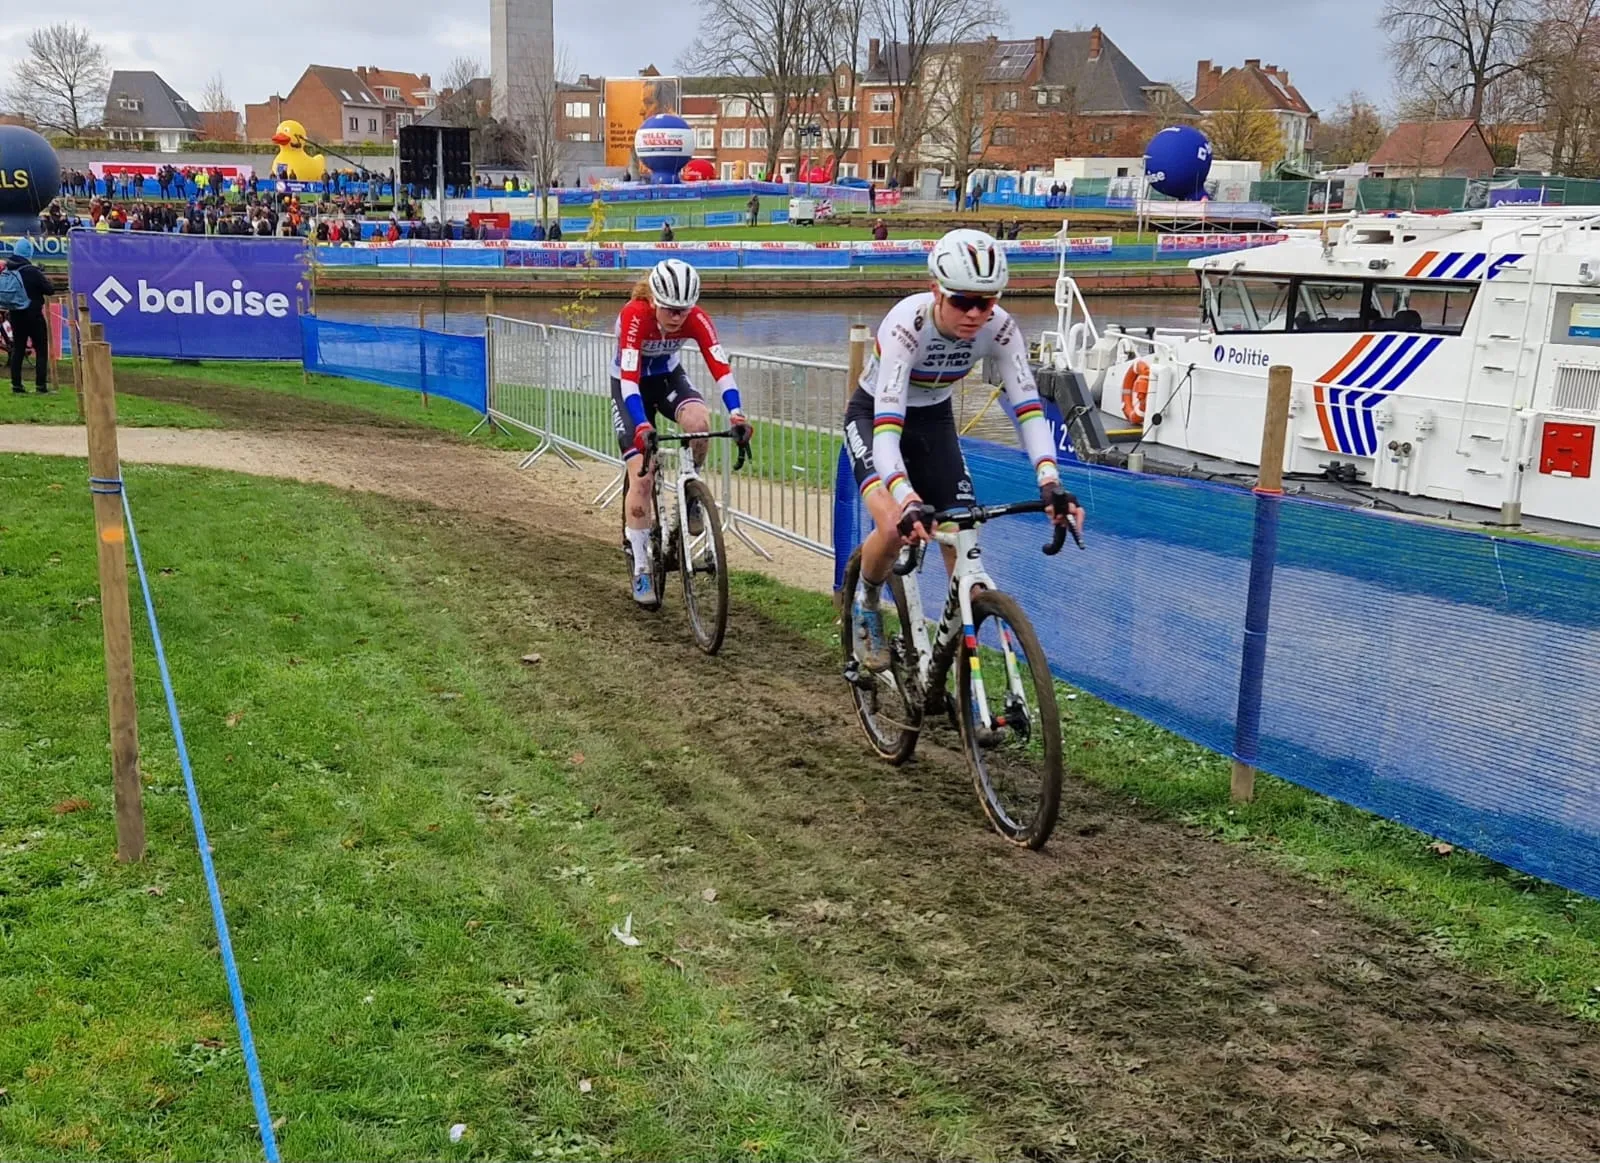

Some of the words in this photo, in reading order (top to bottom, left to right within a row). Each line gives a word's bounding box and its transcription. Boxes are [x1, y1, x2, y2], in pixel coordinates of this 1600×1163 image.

[0, 169, 28, 188] LS
[138, 279, 290, 318] baloise
[626, 315, 641, 349] FENIX
[642, 339, 681, 350] FENIX
[1228, 347, 1270, 366] Politie
